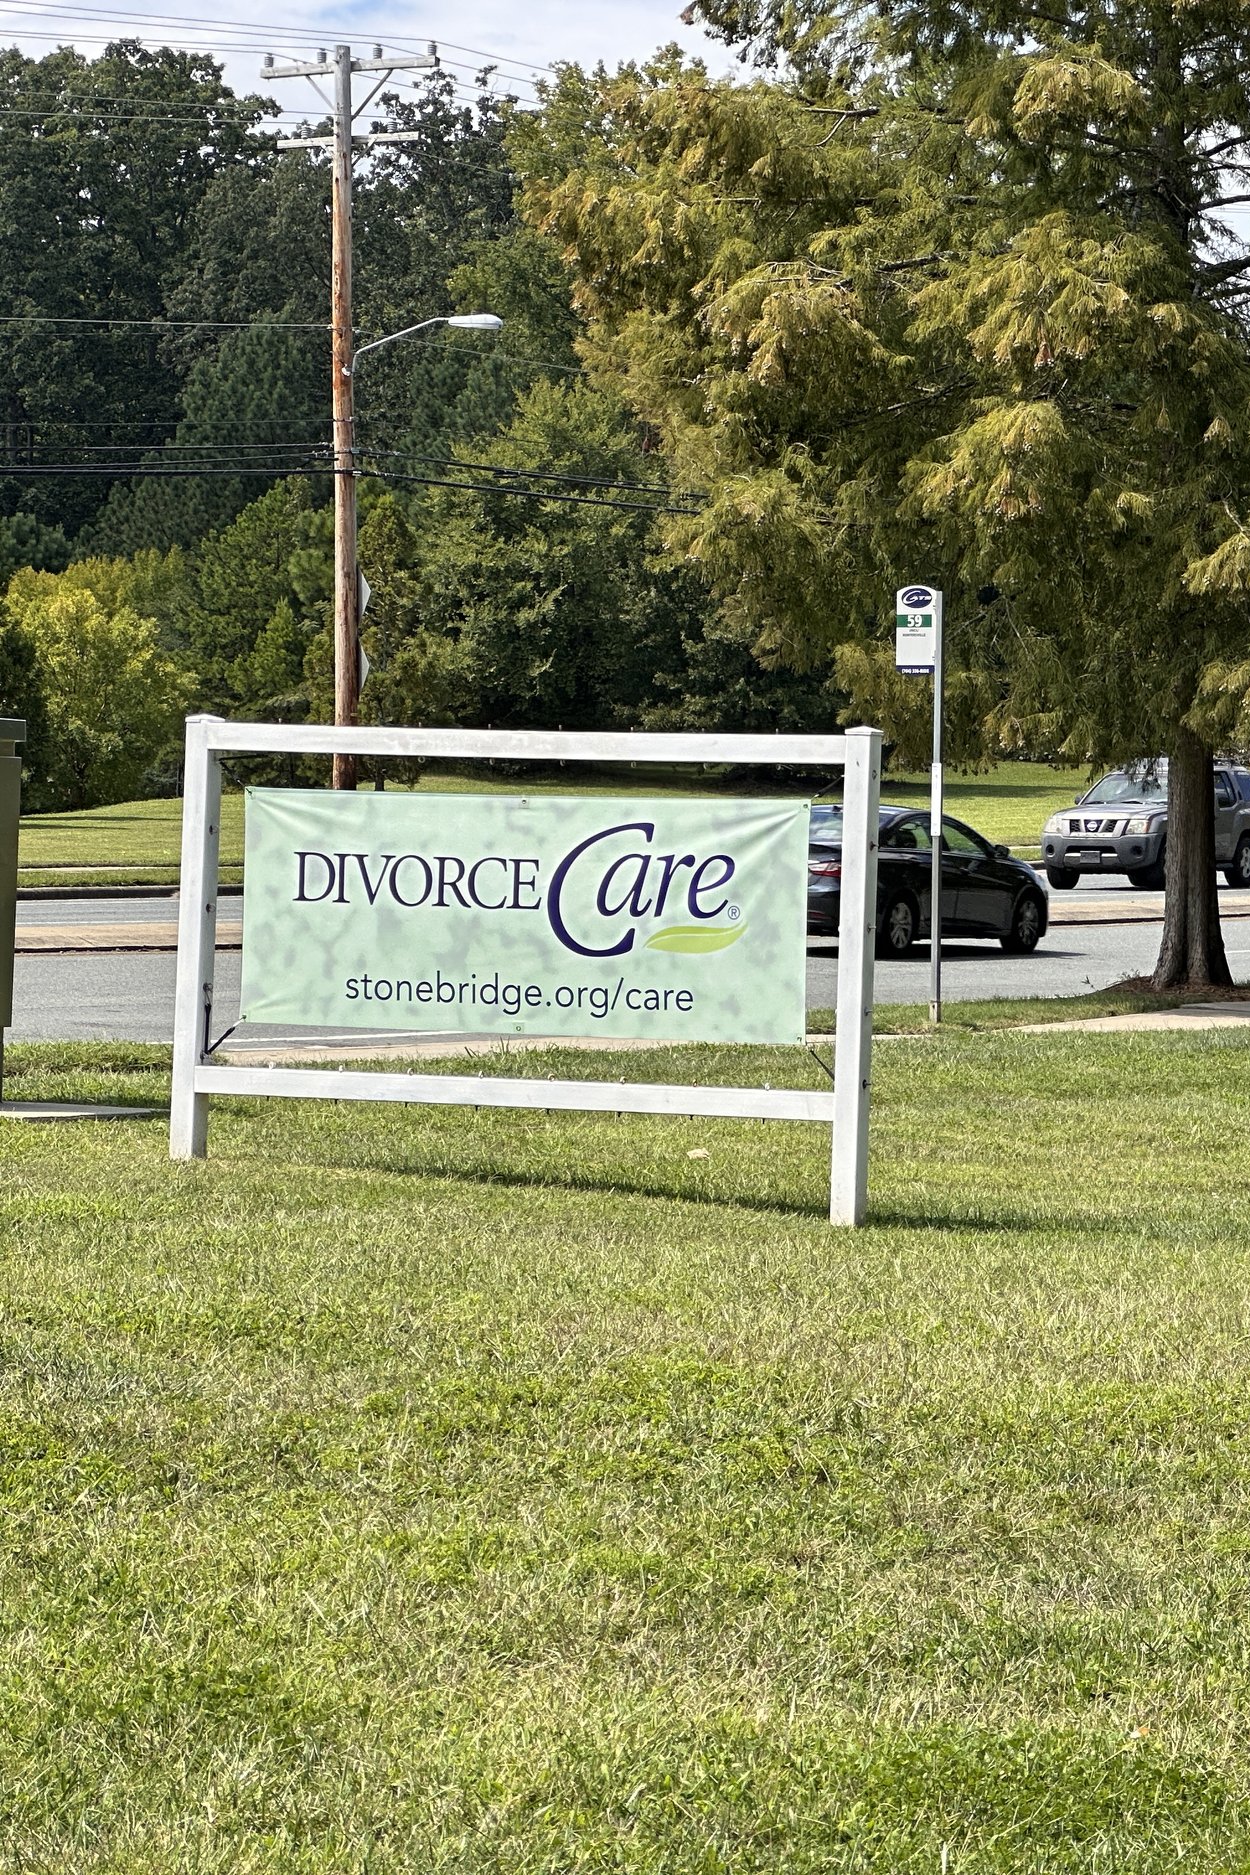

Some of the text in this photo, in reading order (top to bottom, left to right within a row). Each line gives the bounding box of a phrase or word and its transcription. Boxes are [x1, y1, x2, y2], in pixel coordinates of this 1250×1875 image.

[907, 614, 922, 627] 59
[293, 851, 541, 910] DIVORCE
[345, 971, 694, 1018] stonebridge.org/care
